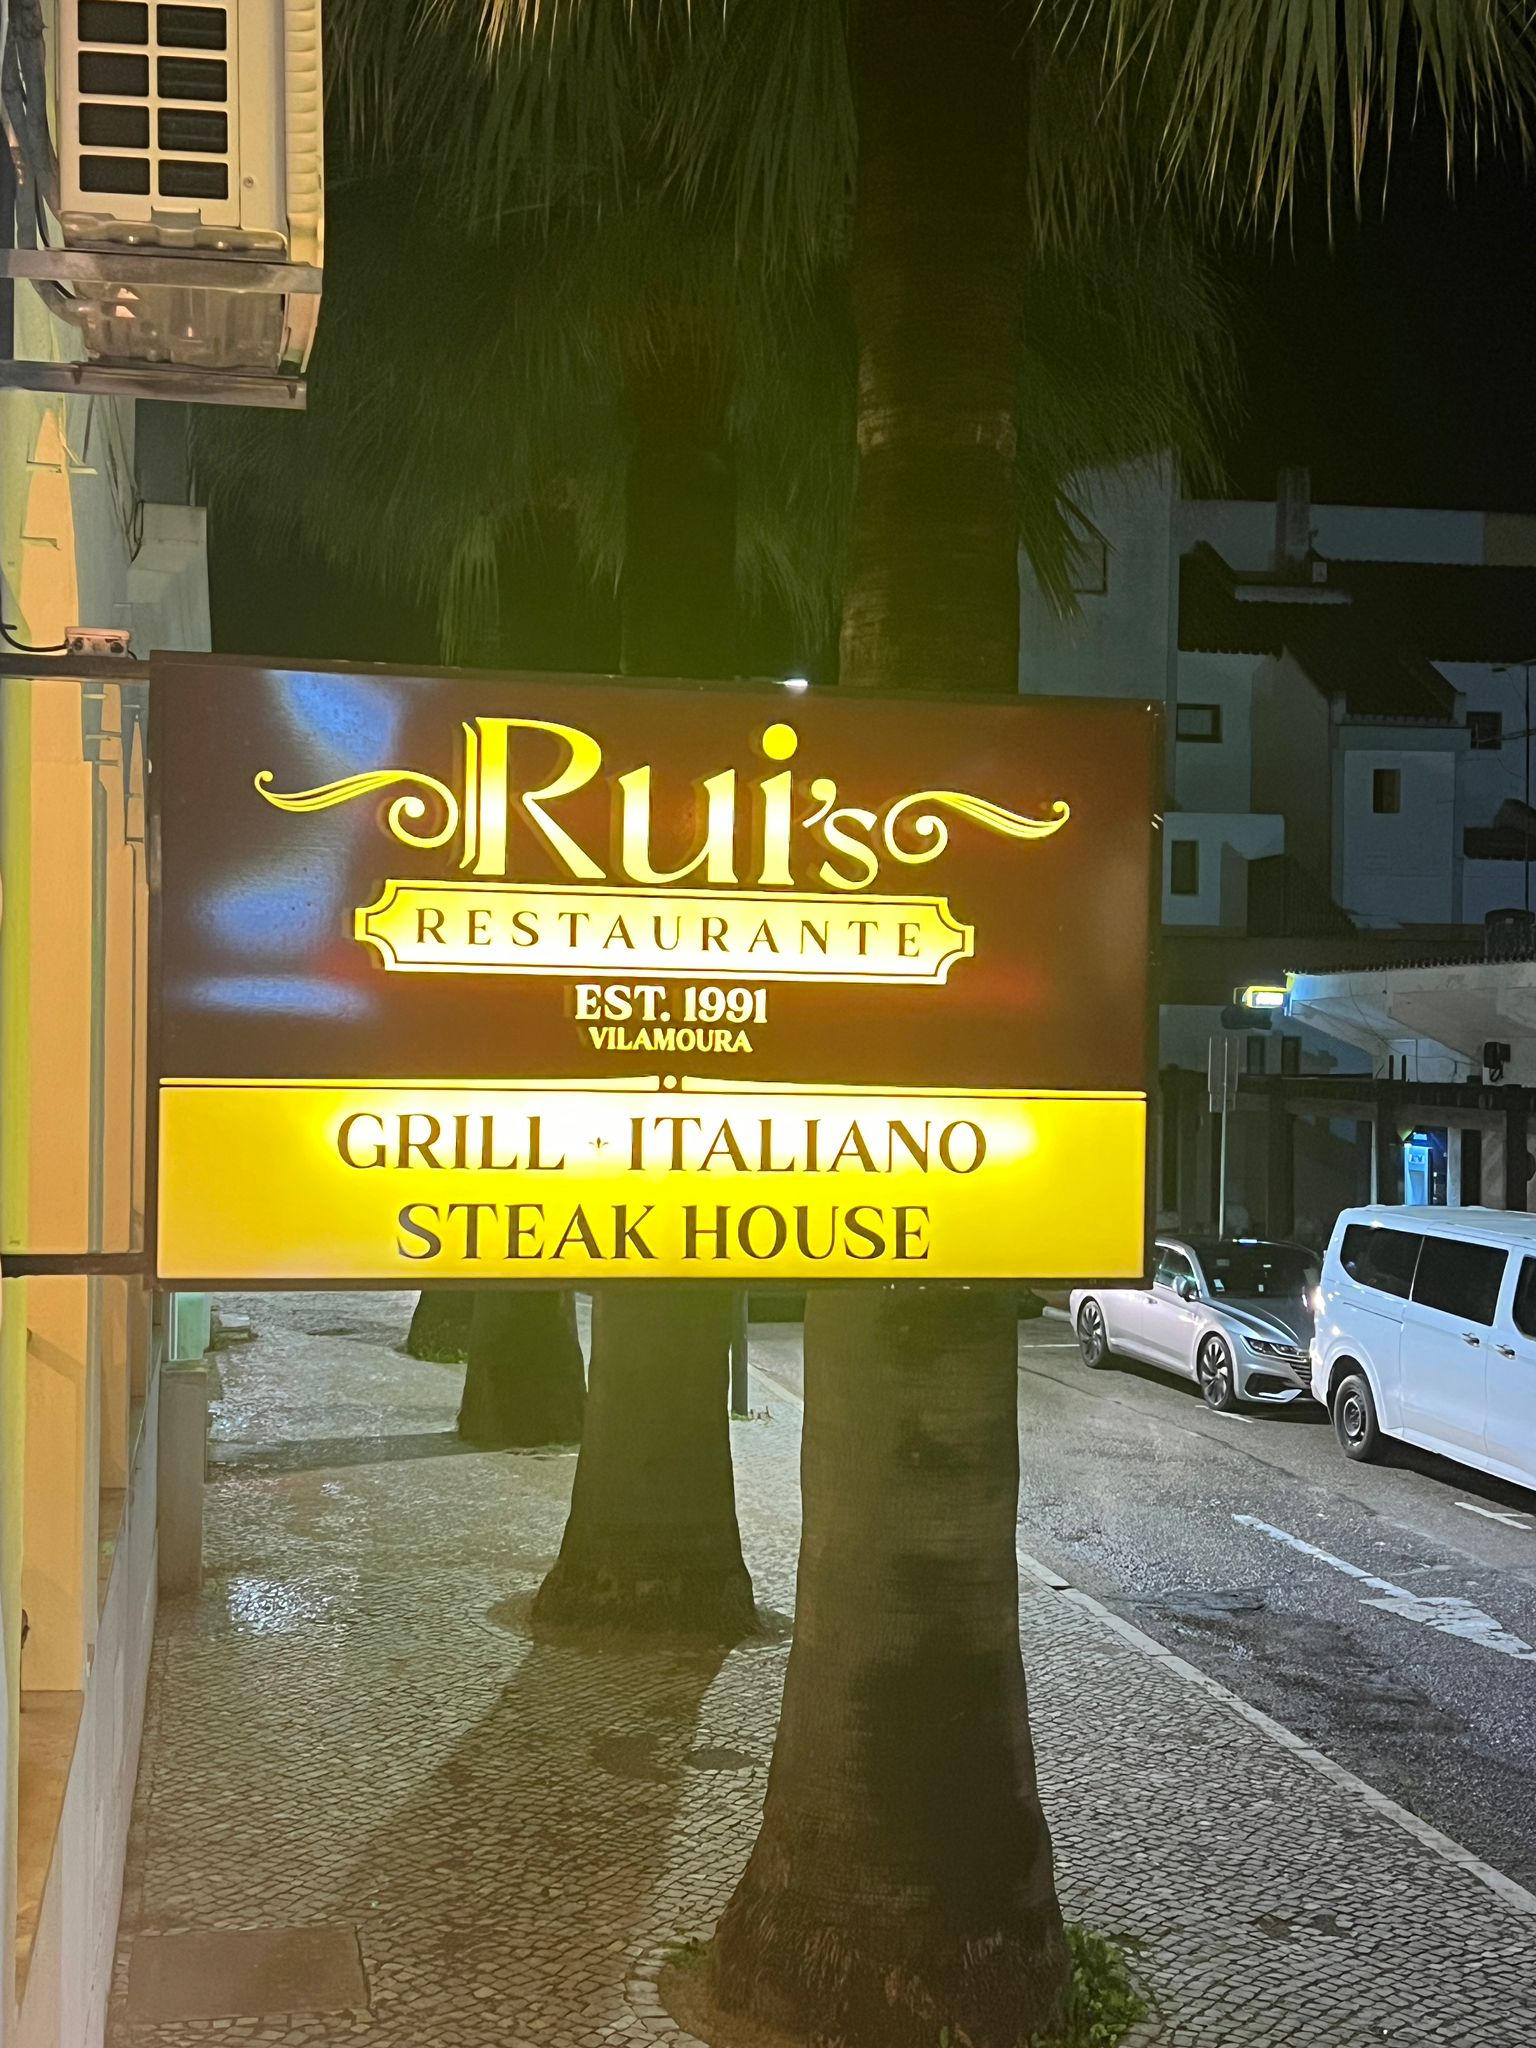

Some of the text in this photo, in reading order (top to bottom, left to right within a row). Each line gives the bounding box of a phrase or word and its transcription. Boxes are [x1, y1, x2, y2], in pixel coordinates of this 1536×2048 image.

[458, 716, 879, 890] Rui's
[416, 907, 921, 957] RESTAURANTE
[575, 984, 768, 1024] EST. 1991
[588, 1026, 754, 1053] VILAMOURA
[337, 1112, 988, 1174] GRILL ITALIANO
[396, 1202, 931, 1260] STEAK HOUSE
